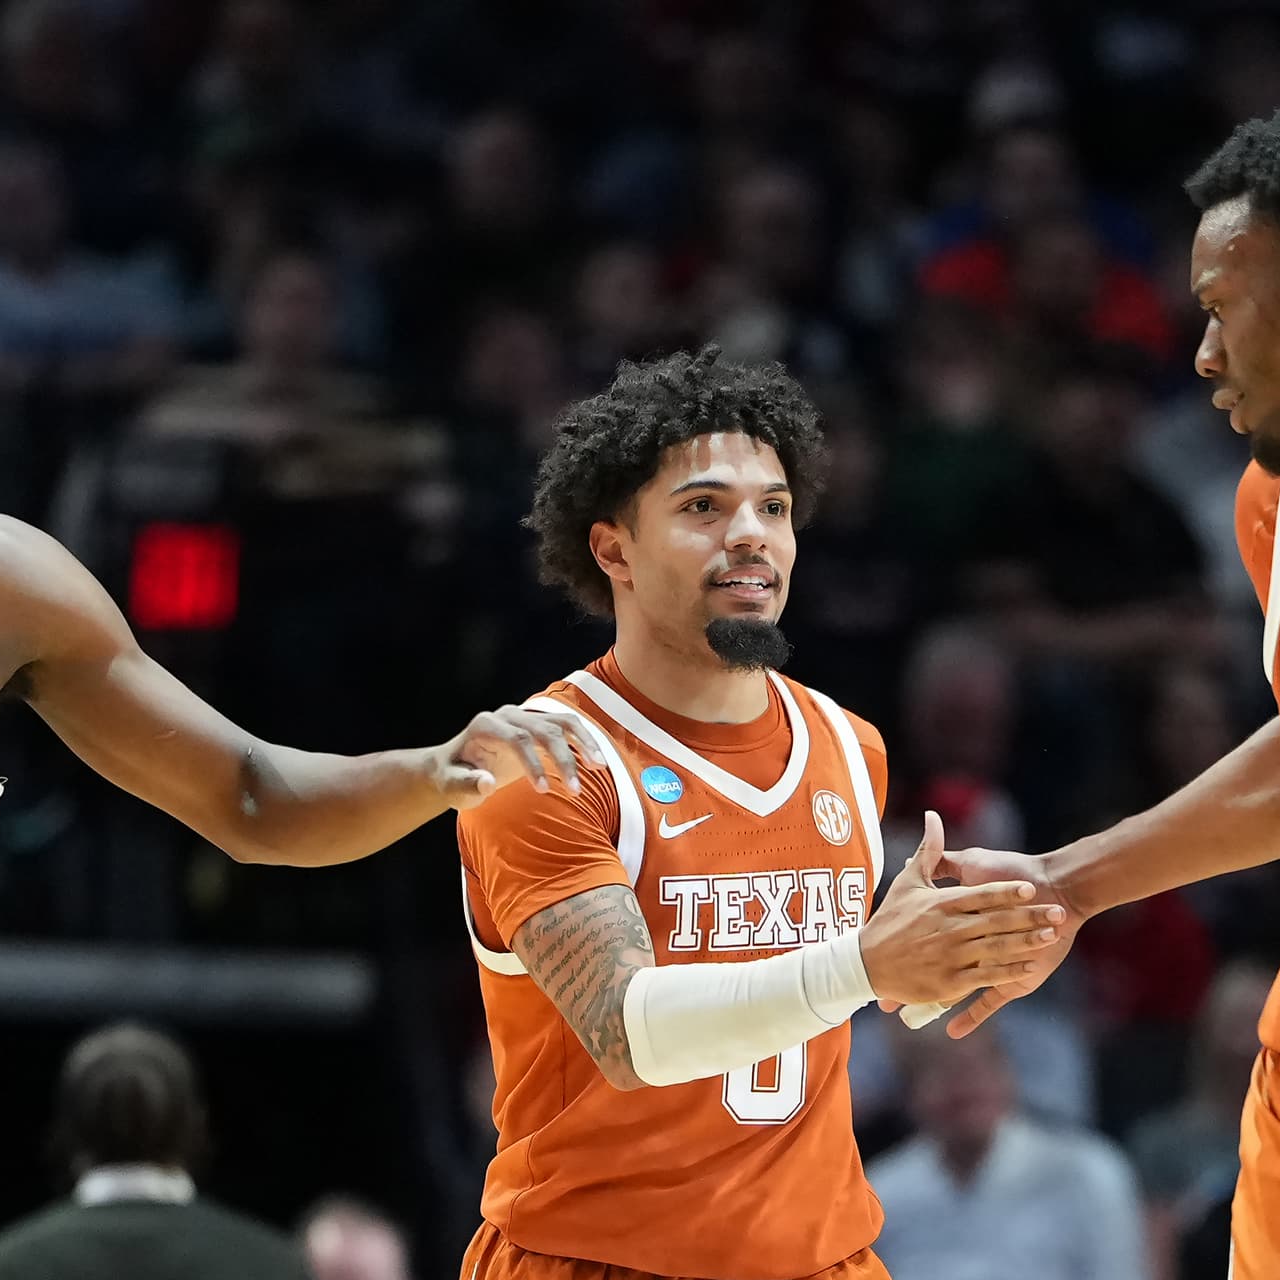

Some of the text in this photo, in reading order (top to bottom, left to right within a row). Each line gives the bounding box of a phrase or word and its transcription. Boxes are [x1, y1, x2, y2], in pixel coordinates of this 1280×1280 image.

[649, 781, 682, 794] NCAA
[814, 794, 850, 841] SEC
[659, 867, 867, 952] TEXAS
